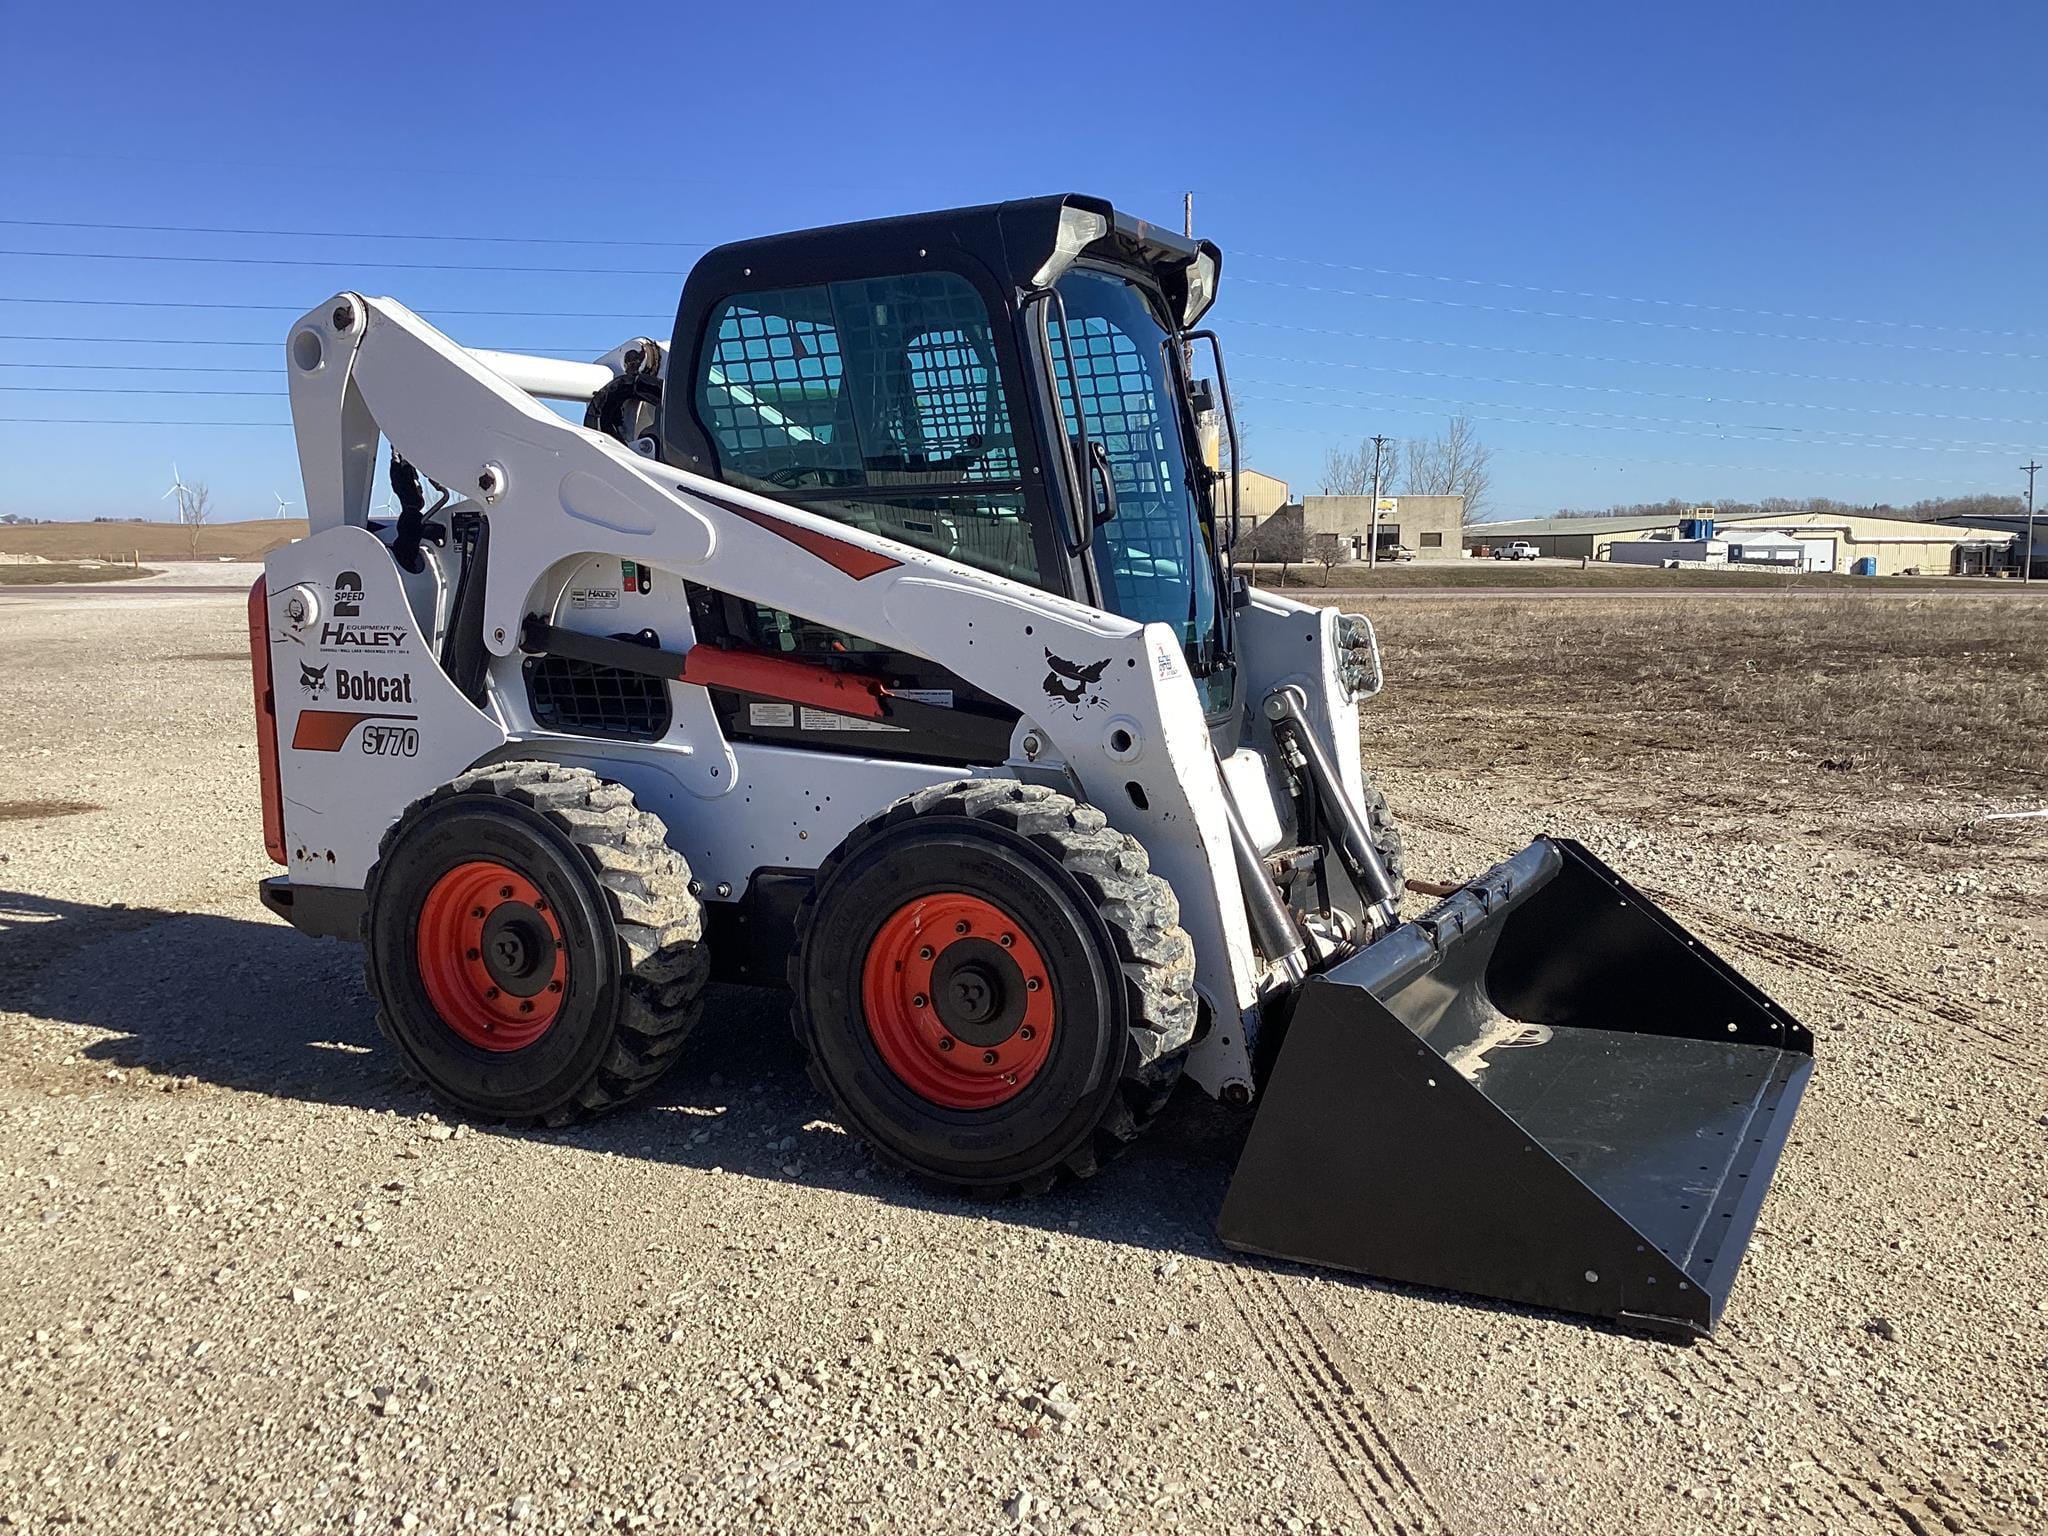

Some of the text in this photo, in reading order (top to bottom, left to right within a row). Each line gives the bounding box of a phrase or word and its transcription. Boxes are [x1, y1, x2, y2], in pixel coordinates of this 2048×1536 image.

[334, 571, 362, 616] 2
[334, 592, 365, 601] SPEED
[320, 622, 408, 647] HALEY
[336, 669, 412, 703] Bobcat
[362, 725, 419, 757] S770
